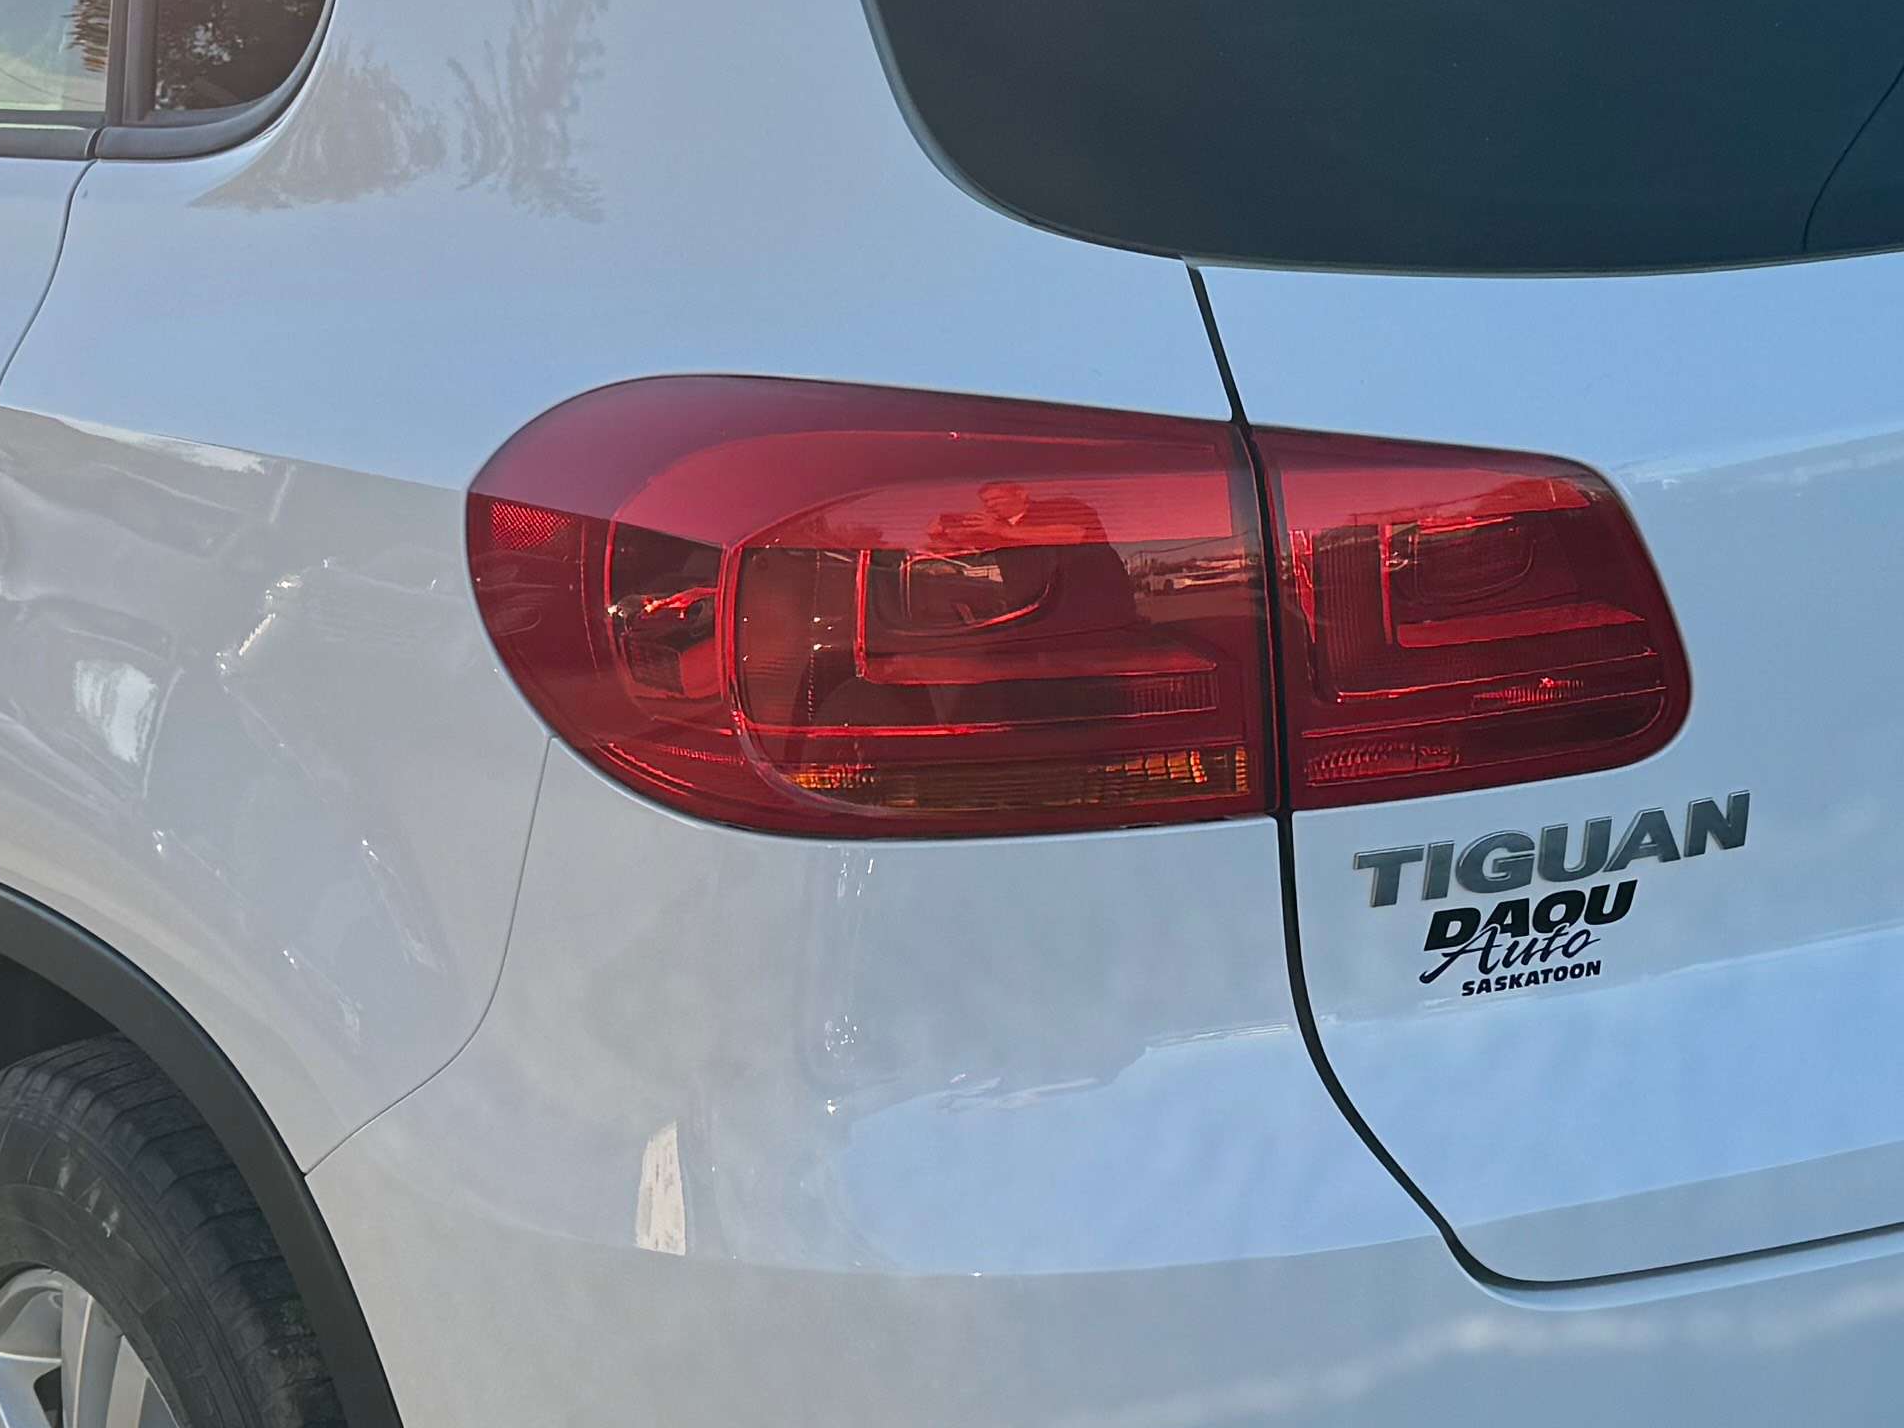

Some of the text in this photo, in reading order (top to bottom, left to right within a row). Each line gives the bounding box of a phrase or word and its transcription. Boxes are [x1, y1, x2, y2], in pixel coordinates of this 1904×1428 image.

[1353, 789, 1751, 907] TIGUAN
[1424, 879, 1638, 951] DAOU
[1419, 922, 1601, 984] Auto
[1461, 959, 1601, 997] SASKATOON
